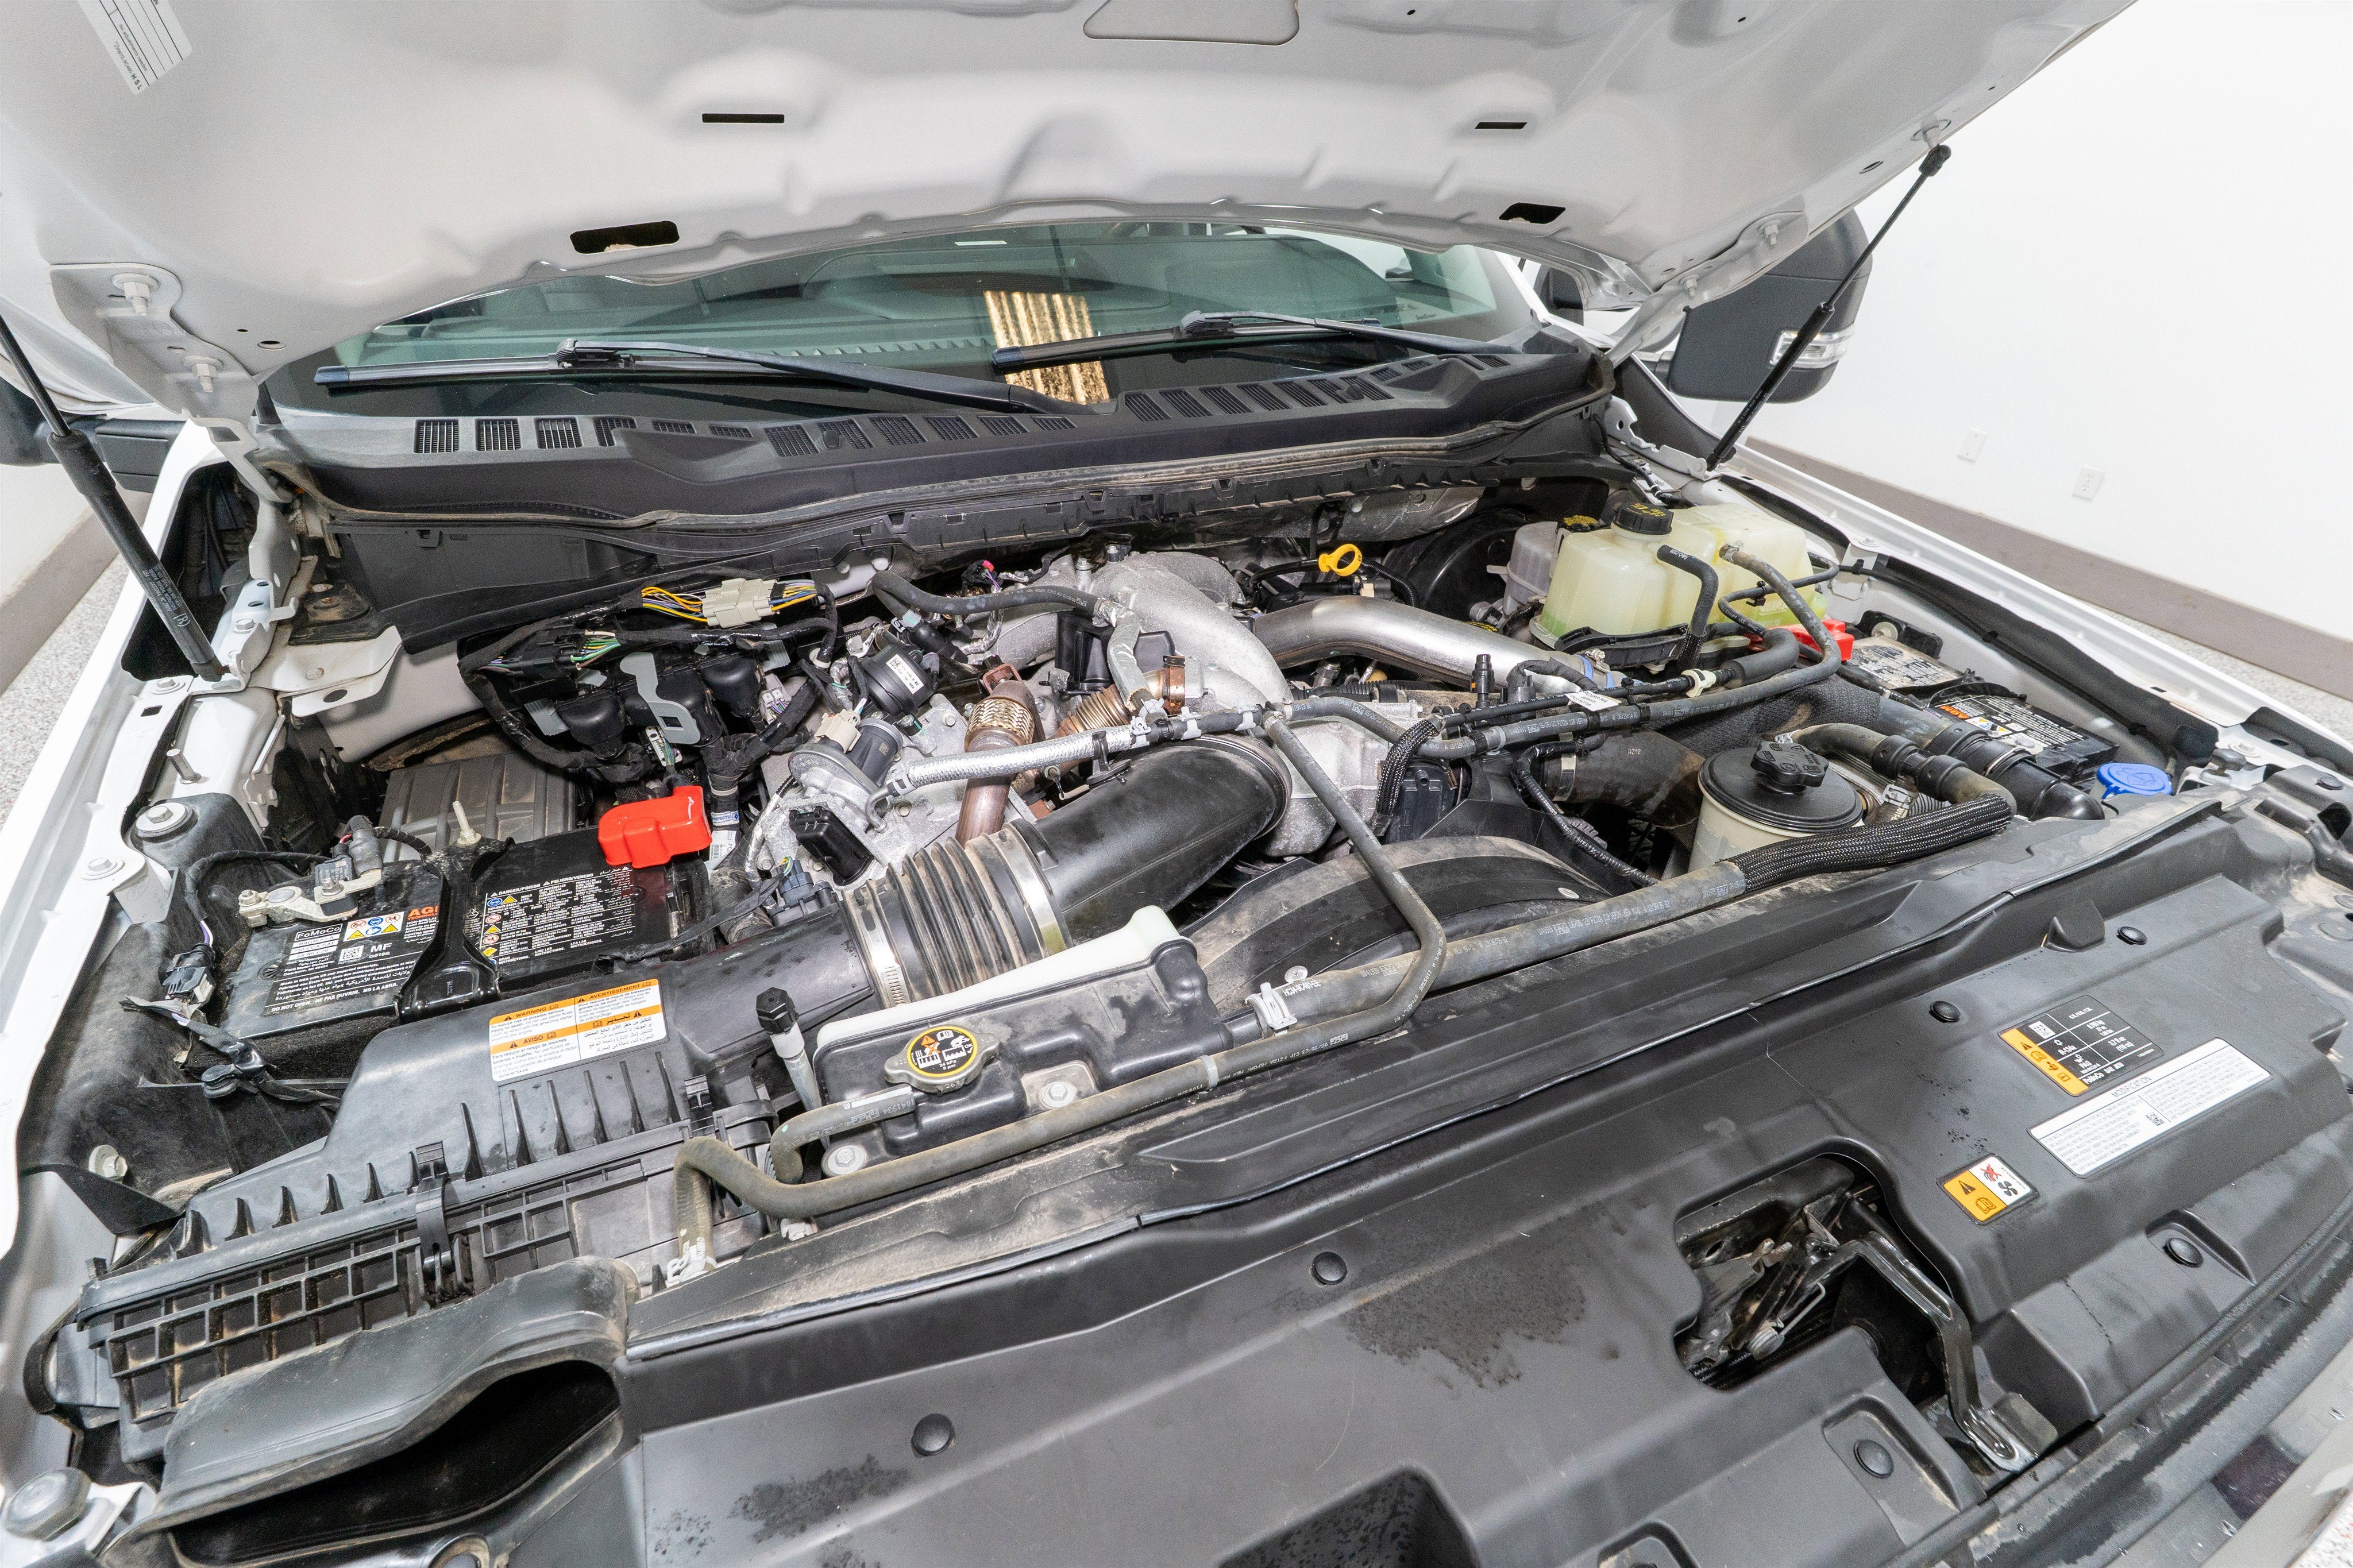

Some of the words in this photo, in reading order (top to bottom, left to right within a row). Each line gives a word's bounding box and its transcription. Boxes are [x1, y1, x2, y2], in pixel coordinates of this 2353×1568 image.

[173, 613, 190, 626] (R)
[550, 872, 593, 884] PELIGRO/VENENO
[498, 883, 540, 895] DANGER/POISON
[296, 925, 341, 940] FoMoCo
[369, 941, 392, 953] MF
[570, 939, 603, 948] INSTRUCCIONES.
[534, 947, 565, 956] INSTRUCTIONS.
[498, 955, 530, 964] INSTRUCTIONS.
[380, 981, 399, 990] ABRA.
[589, 983, 641, 999] AVERTISSEMENT
[335, 989, 361, 998] OUVRIR.
[294, 999, 313, 1007] OPEN.
[515, 1007, 546, 1017] WARNING
[523, 1034, 543, 1044] AVISO
[2057, 1044, 2078, 1056] R-134a
[2078, 1060, 2093, 1069] PAG
[2081, 1071, 2105, 1084] FoMoCo
[2110, 1075, 2153, 1098] MODIFICATION
